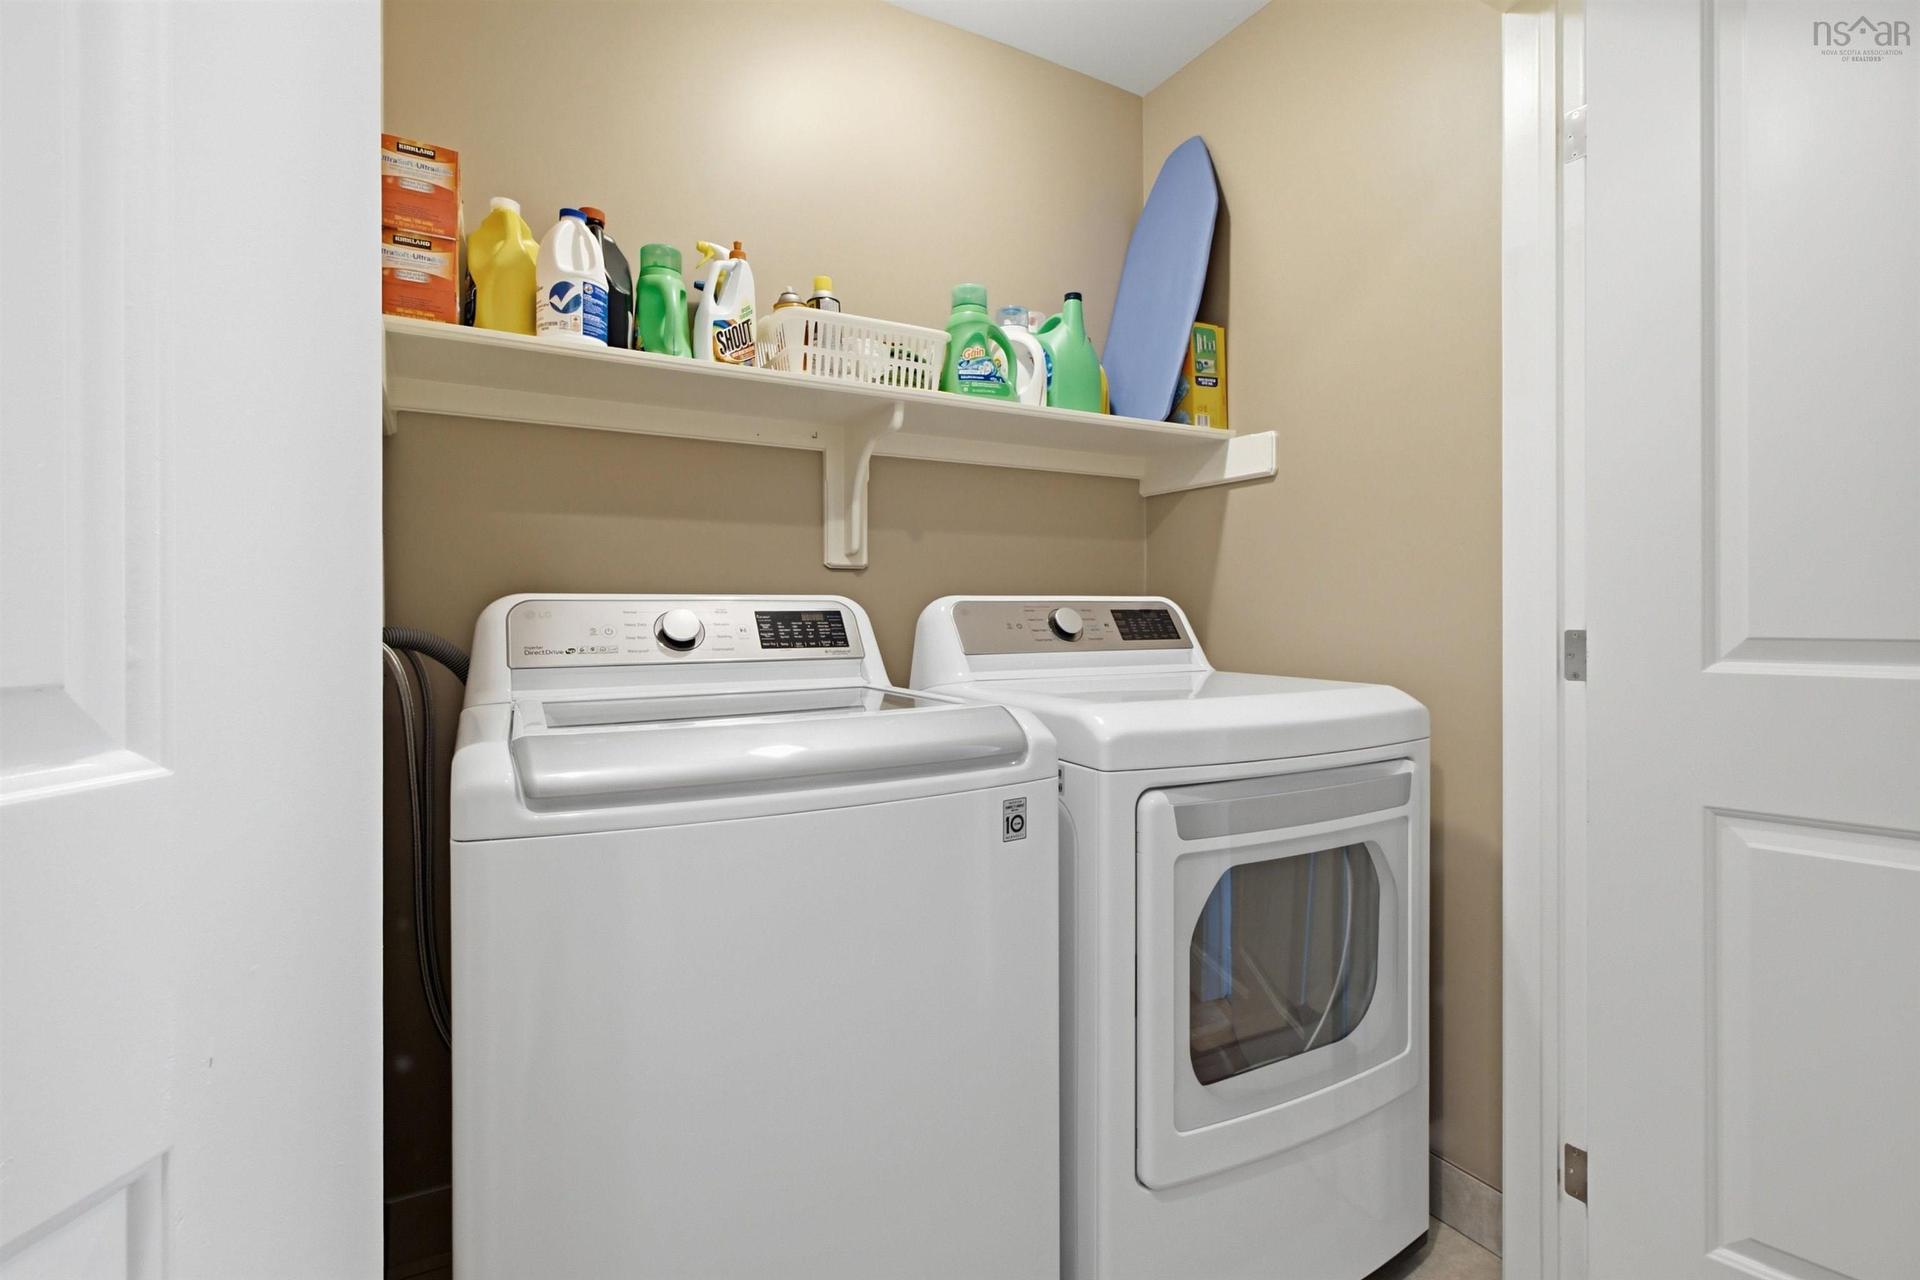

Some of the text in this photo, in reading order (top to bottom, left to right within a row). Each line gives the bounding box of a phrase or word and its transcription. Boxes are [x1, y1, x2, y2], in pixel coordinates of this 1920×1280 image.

[398, 143, 434, 156] KIRKLAND
[394, 235, 430, 248] KIRKLAND
[716, 319, 752, 355] SHOUT
[963, 346, 985, 360] Gain
